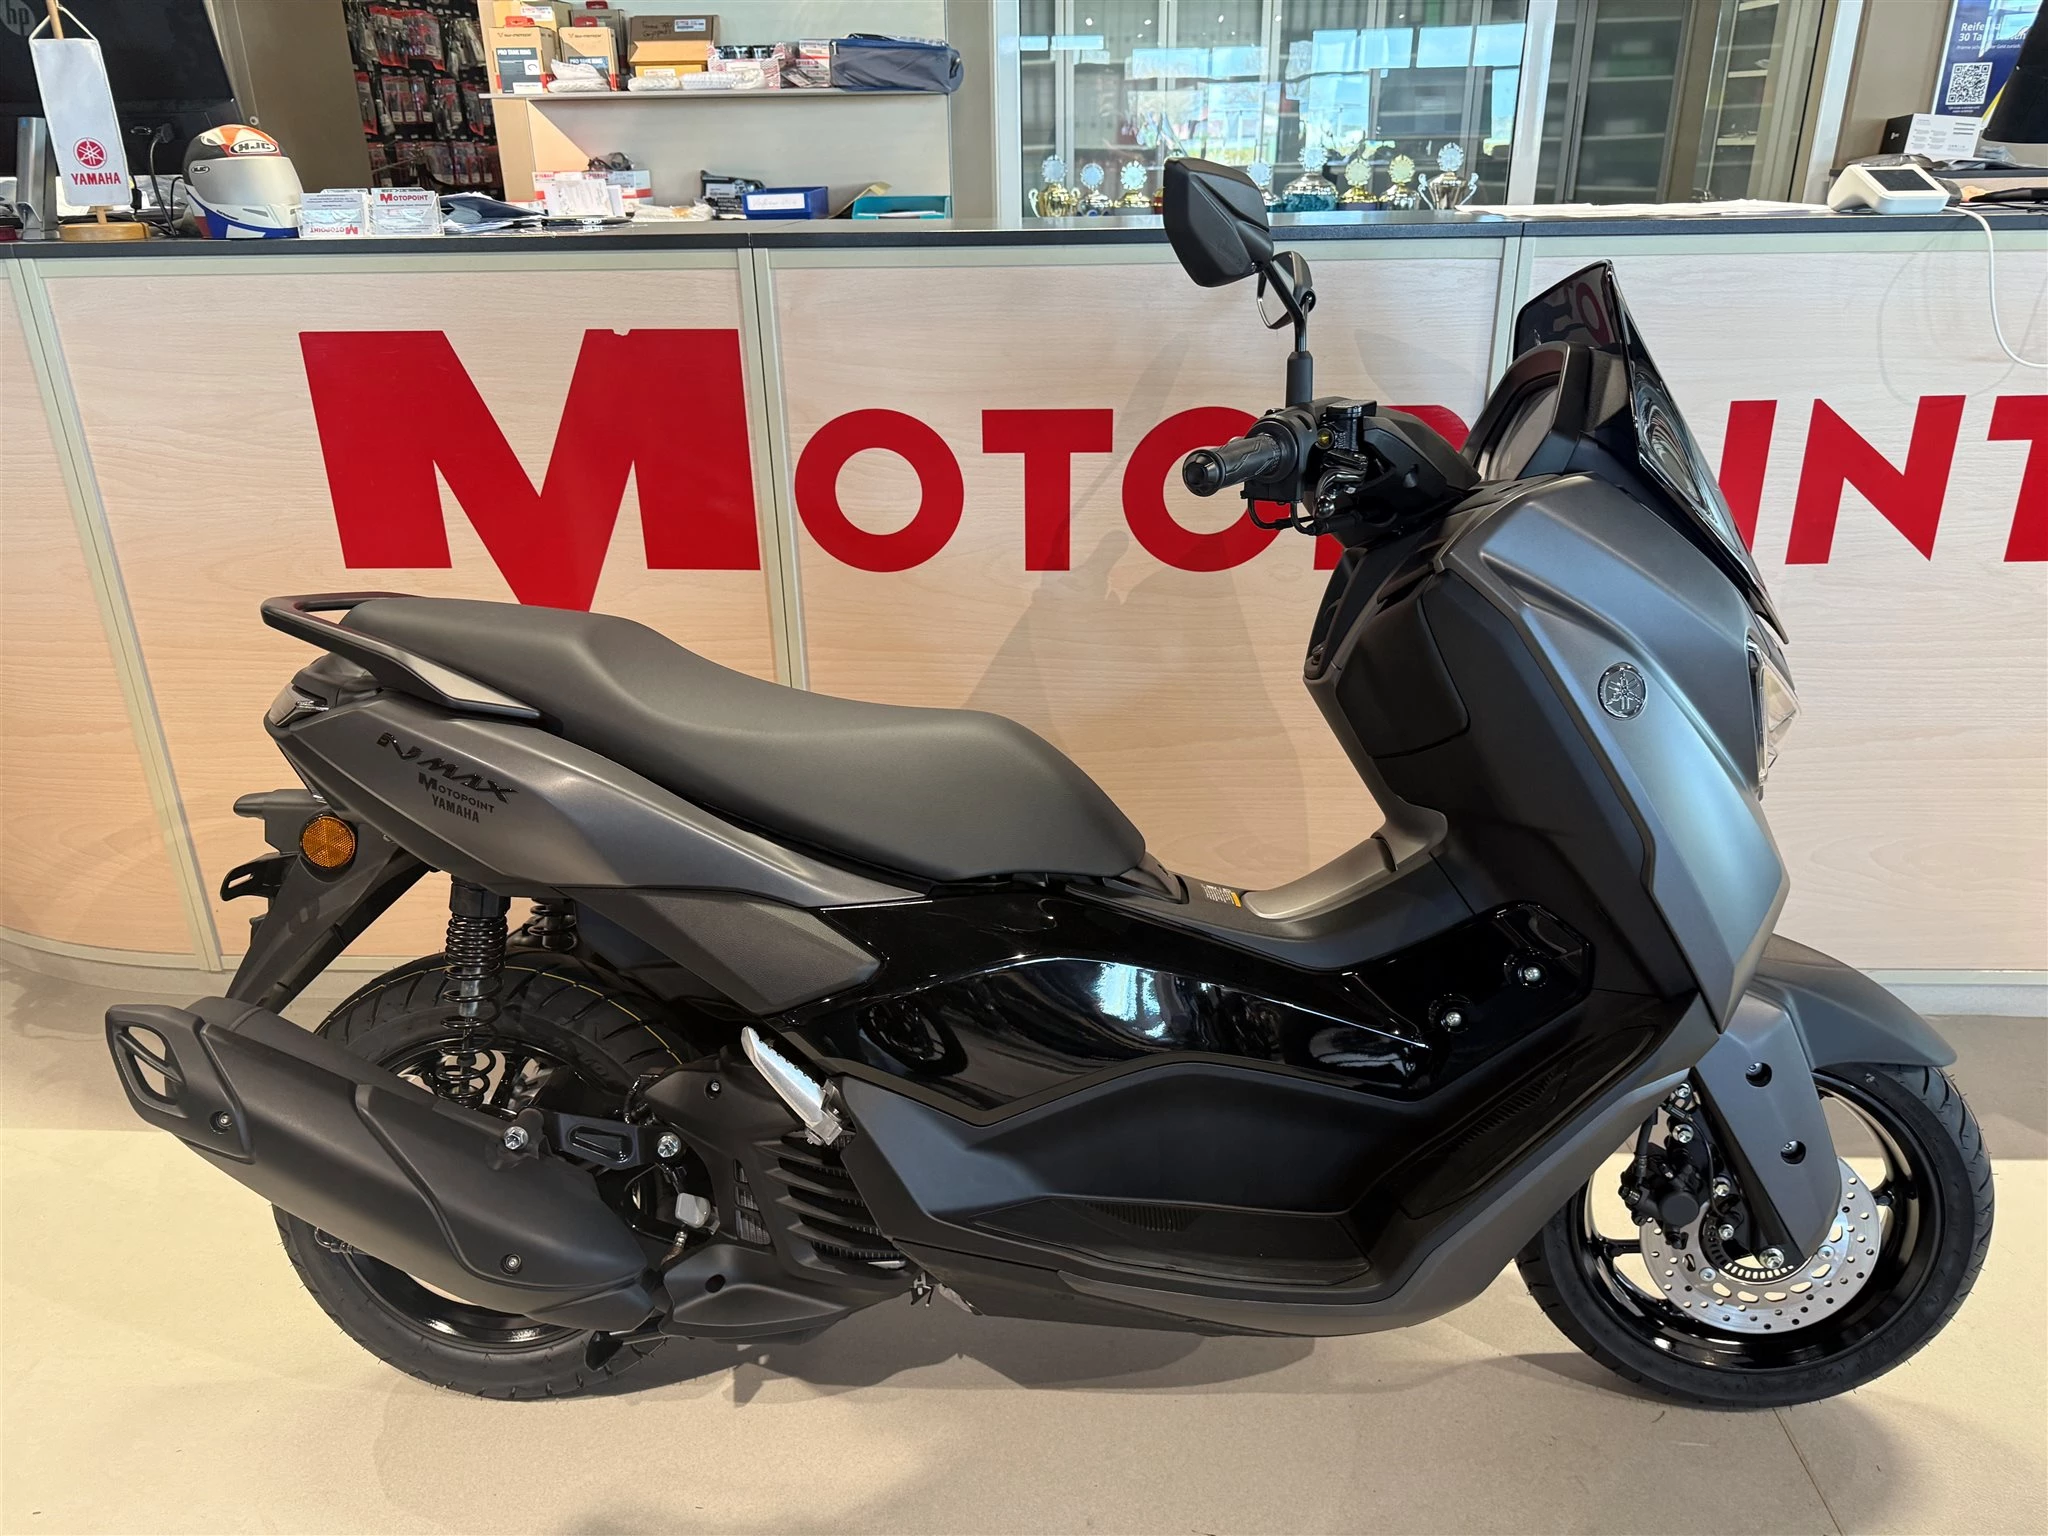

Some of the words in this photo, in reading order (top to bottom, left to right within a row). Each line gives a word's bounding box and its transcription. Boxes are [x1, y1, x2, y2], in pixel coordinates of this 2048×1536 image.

[6, 0, 30, 36] hp
[1959, 33, 1971, 42] 30
[238, 144, 271, 152] HJC
[71, 172, 121, 185] YAMAHA
[380, 193, 429, 204] MOTOPOINT
[299, 329, 2048, 612] MOTOINT
[418, 772, 495, 814] MOTOPOINT
[431, 793, 480, 823] YAMAHA
